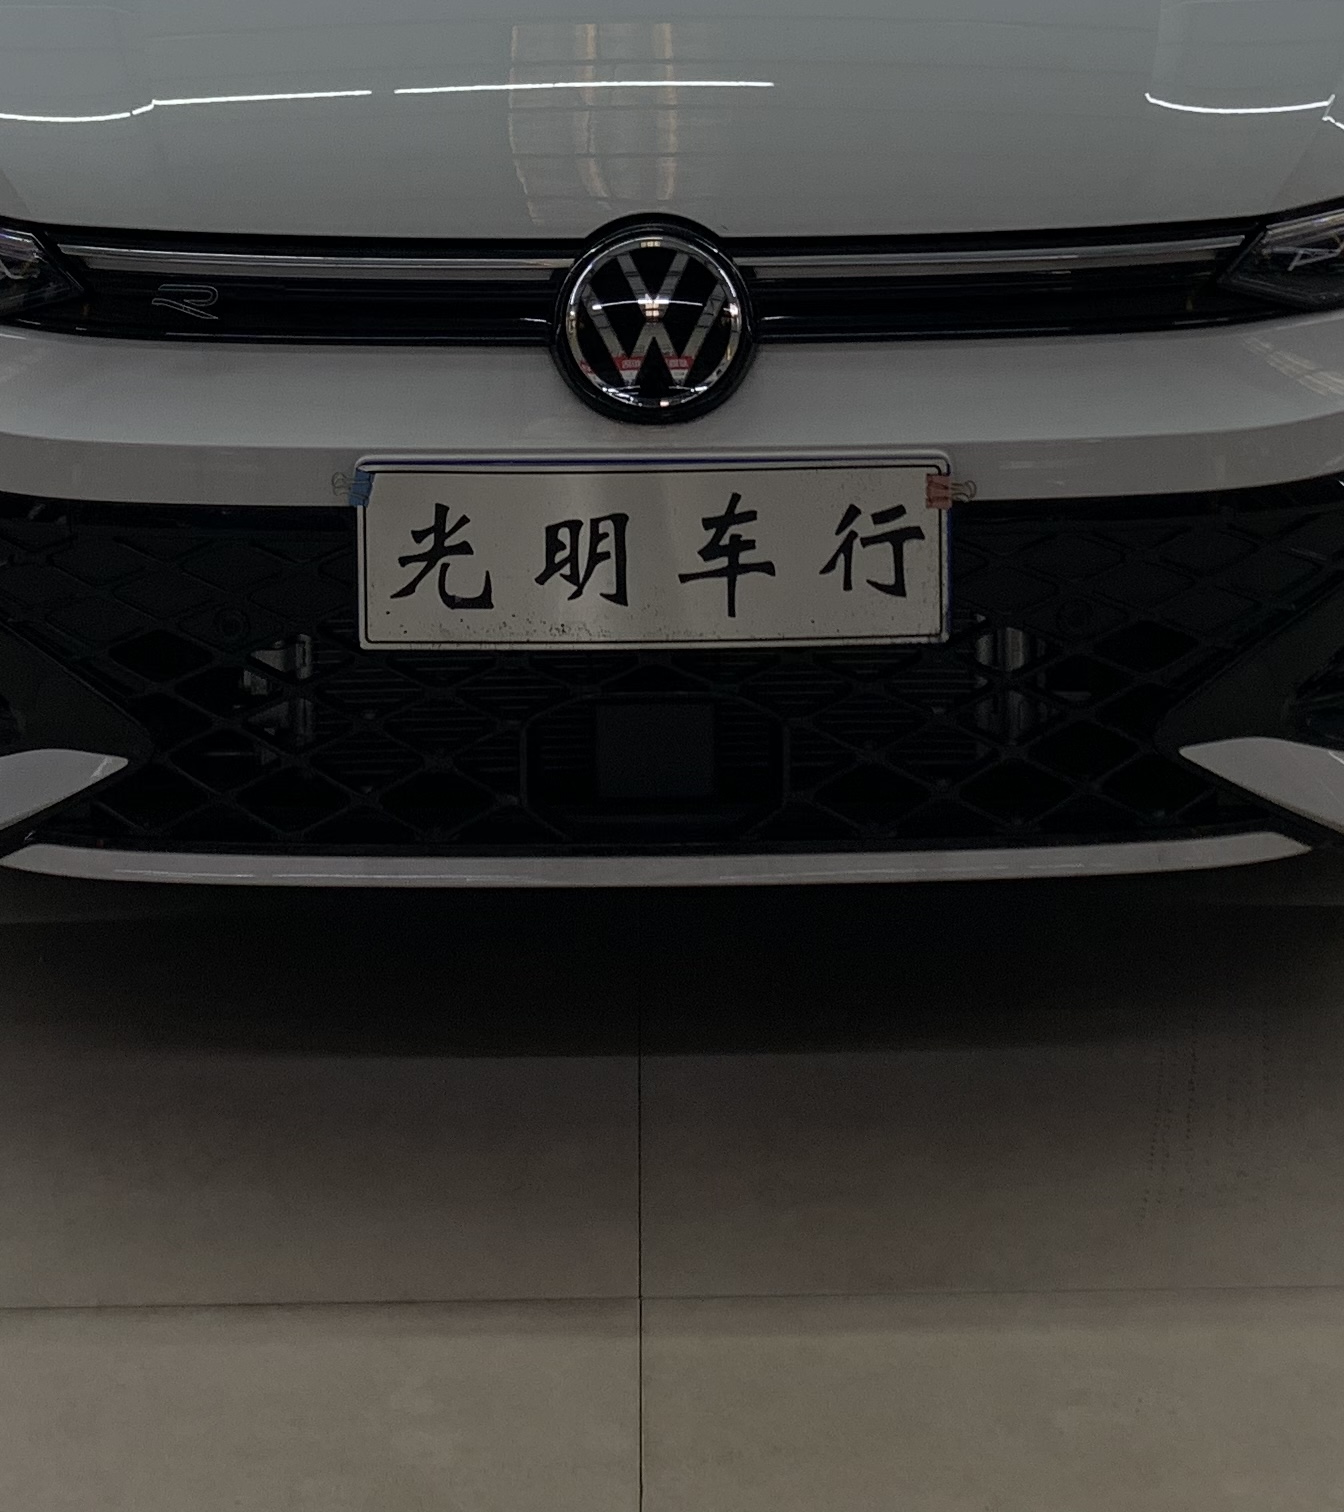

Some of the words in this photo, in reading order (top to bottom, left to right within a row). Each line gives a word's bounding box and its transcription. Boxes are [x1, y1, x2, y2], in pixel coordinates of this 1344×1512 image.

[151, 283, 219, 320] R
[388, 491, 926, 618] 光明车行
